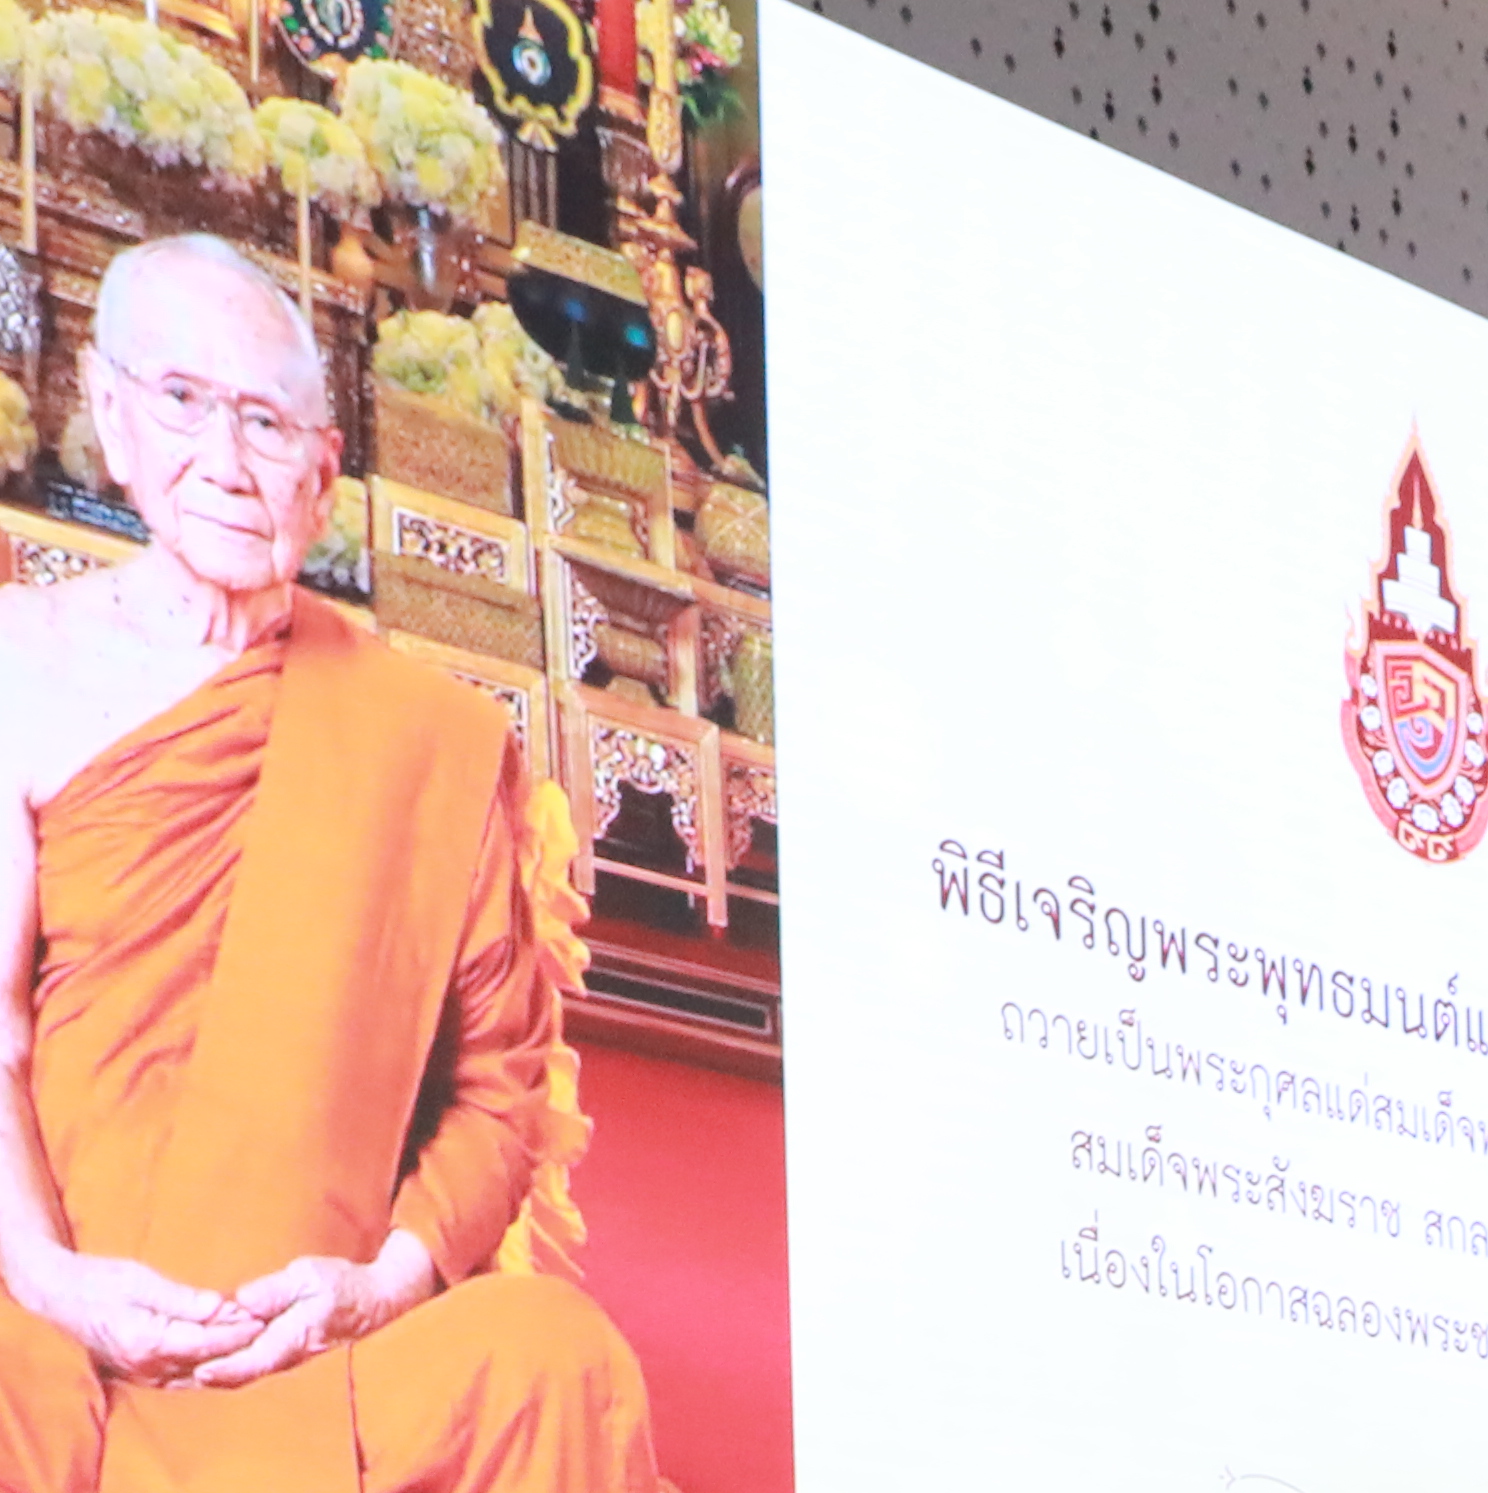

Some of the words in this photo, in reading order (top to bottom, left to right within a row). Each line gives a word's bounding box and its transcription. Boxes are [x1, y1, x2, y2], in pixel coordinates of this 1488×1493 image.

[1070, 1124, 1401, 1238] สมเด็จพระสังฆราช
